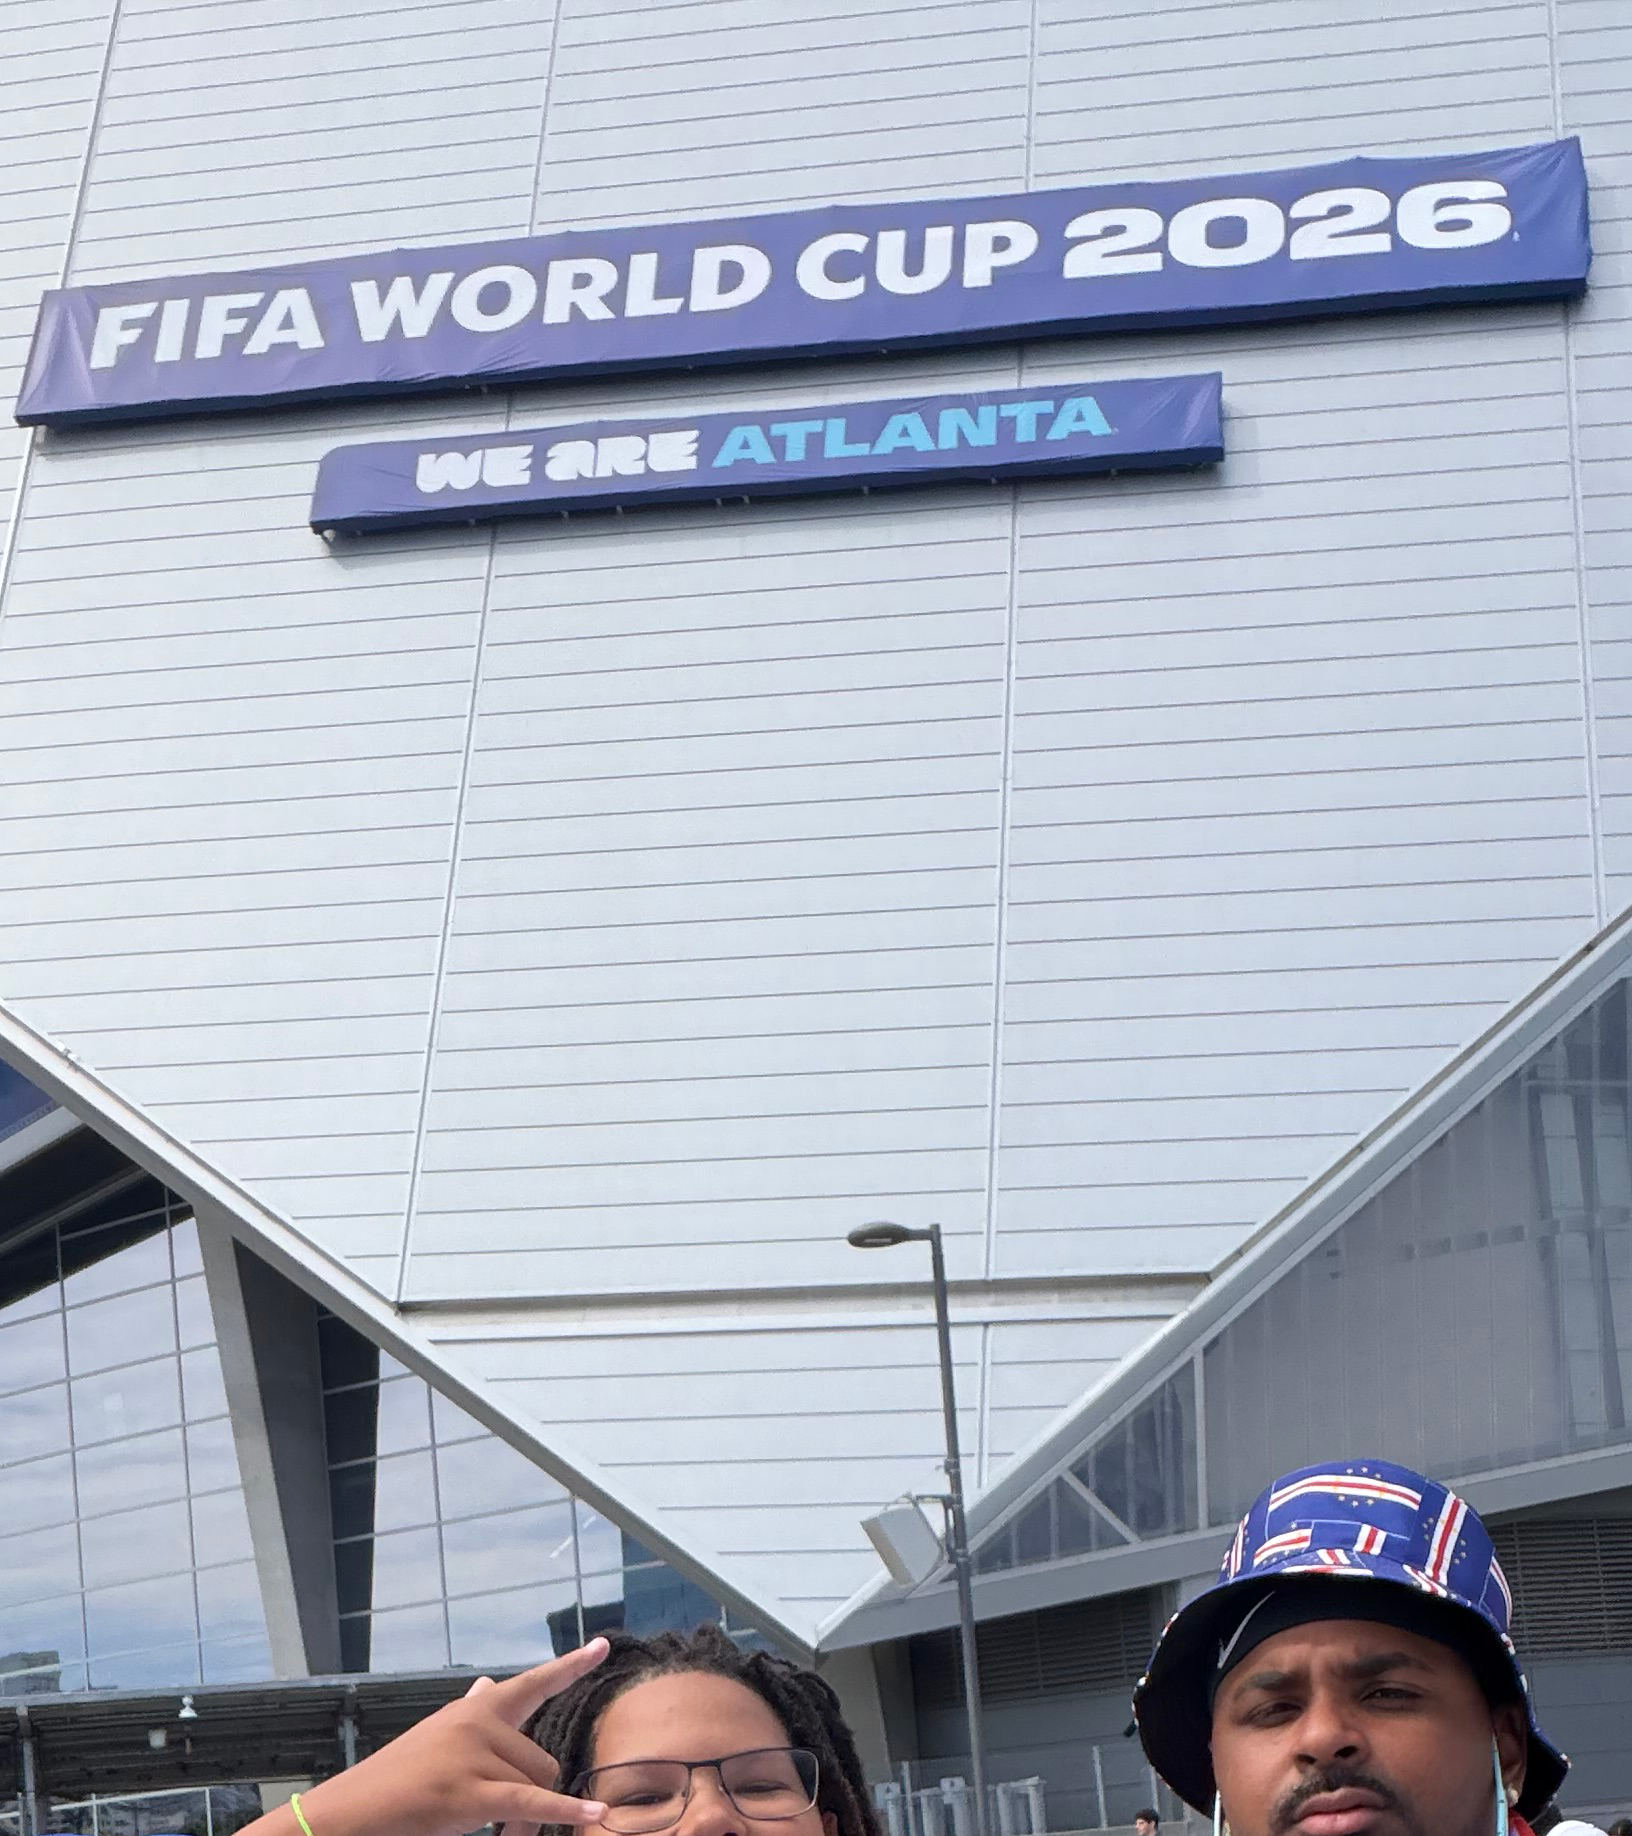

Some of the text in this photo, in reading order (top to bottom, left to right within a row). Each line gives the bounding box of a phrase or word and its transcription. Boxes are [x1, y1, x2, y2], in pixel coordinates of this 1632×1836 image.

[90, 180, 1512, 369] FIFA WORLD CUP 2026
[415, 445, 532, 493] WE
[712, 396, 1111, 468] ATLANTA
